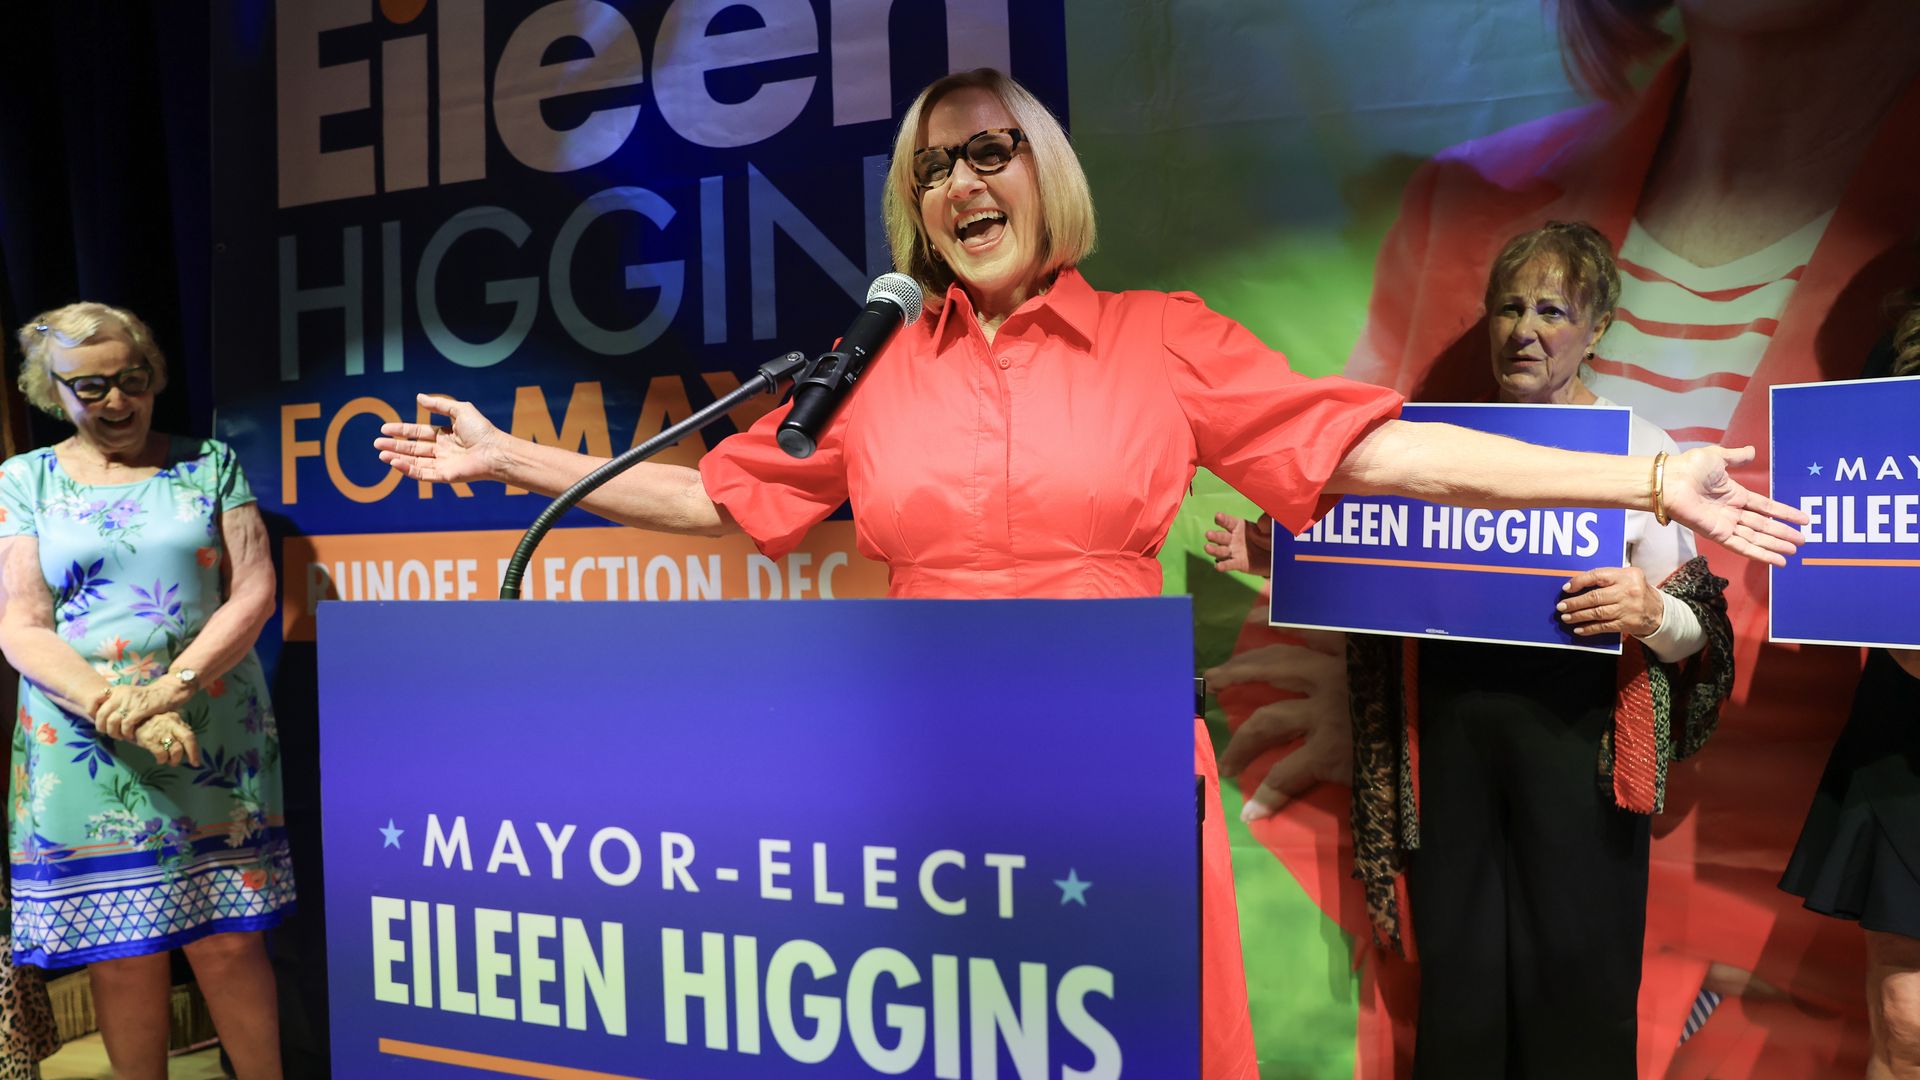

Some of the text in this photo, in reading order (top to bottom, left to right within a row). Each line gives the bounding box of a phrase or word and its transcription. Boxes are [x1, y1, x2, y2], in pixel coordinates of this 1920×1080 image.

[276, 0, 1010, 208] Eileen
[1294, 503, 1600, 558] LEEN HIGGINS
[1800, 495, 1919, 543] EILEE
[497, 554, 722, 600] LECTION
[422, 813, 1027, 919] MAYOR-ELECT
[371, 895, 1123, 1080] EILEEN HIGGINS
